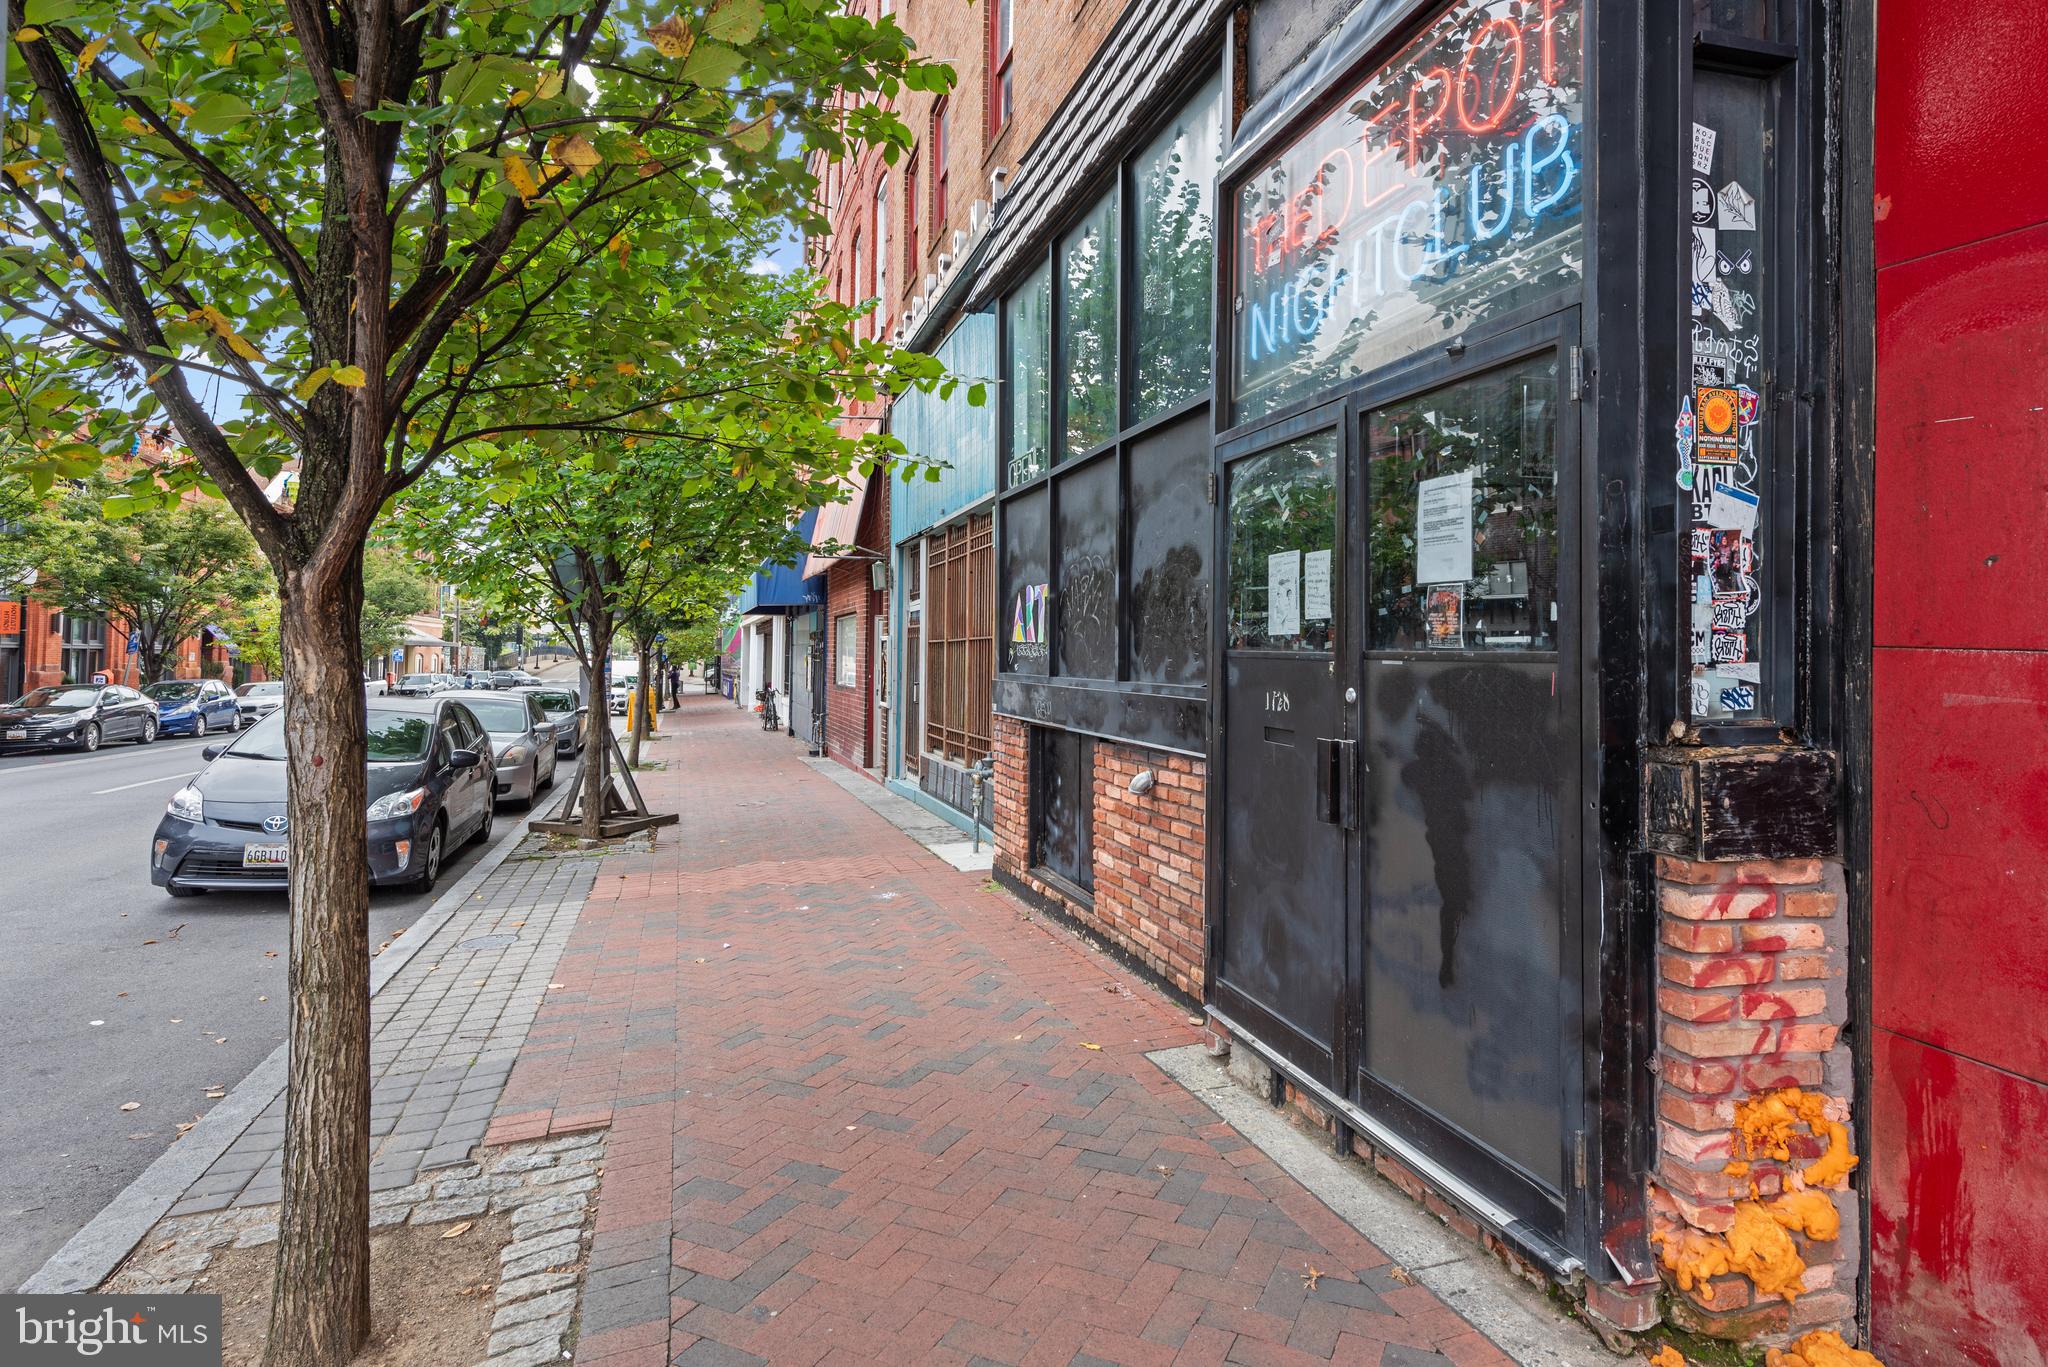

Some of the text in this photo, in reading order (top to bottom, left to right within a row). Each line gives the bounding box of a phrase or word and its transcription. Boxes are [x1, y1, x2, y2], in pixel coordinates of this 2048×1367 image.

[1316, 0, 1583, 232] DEPOT
[1012, 583, 1049, 643] ART
[1265, 690, 1290, 712] 1728
